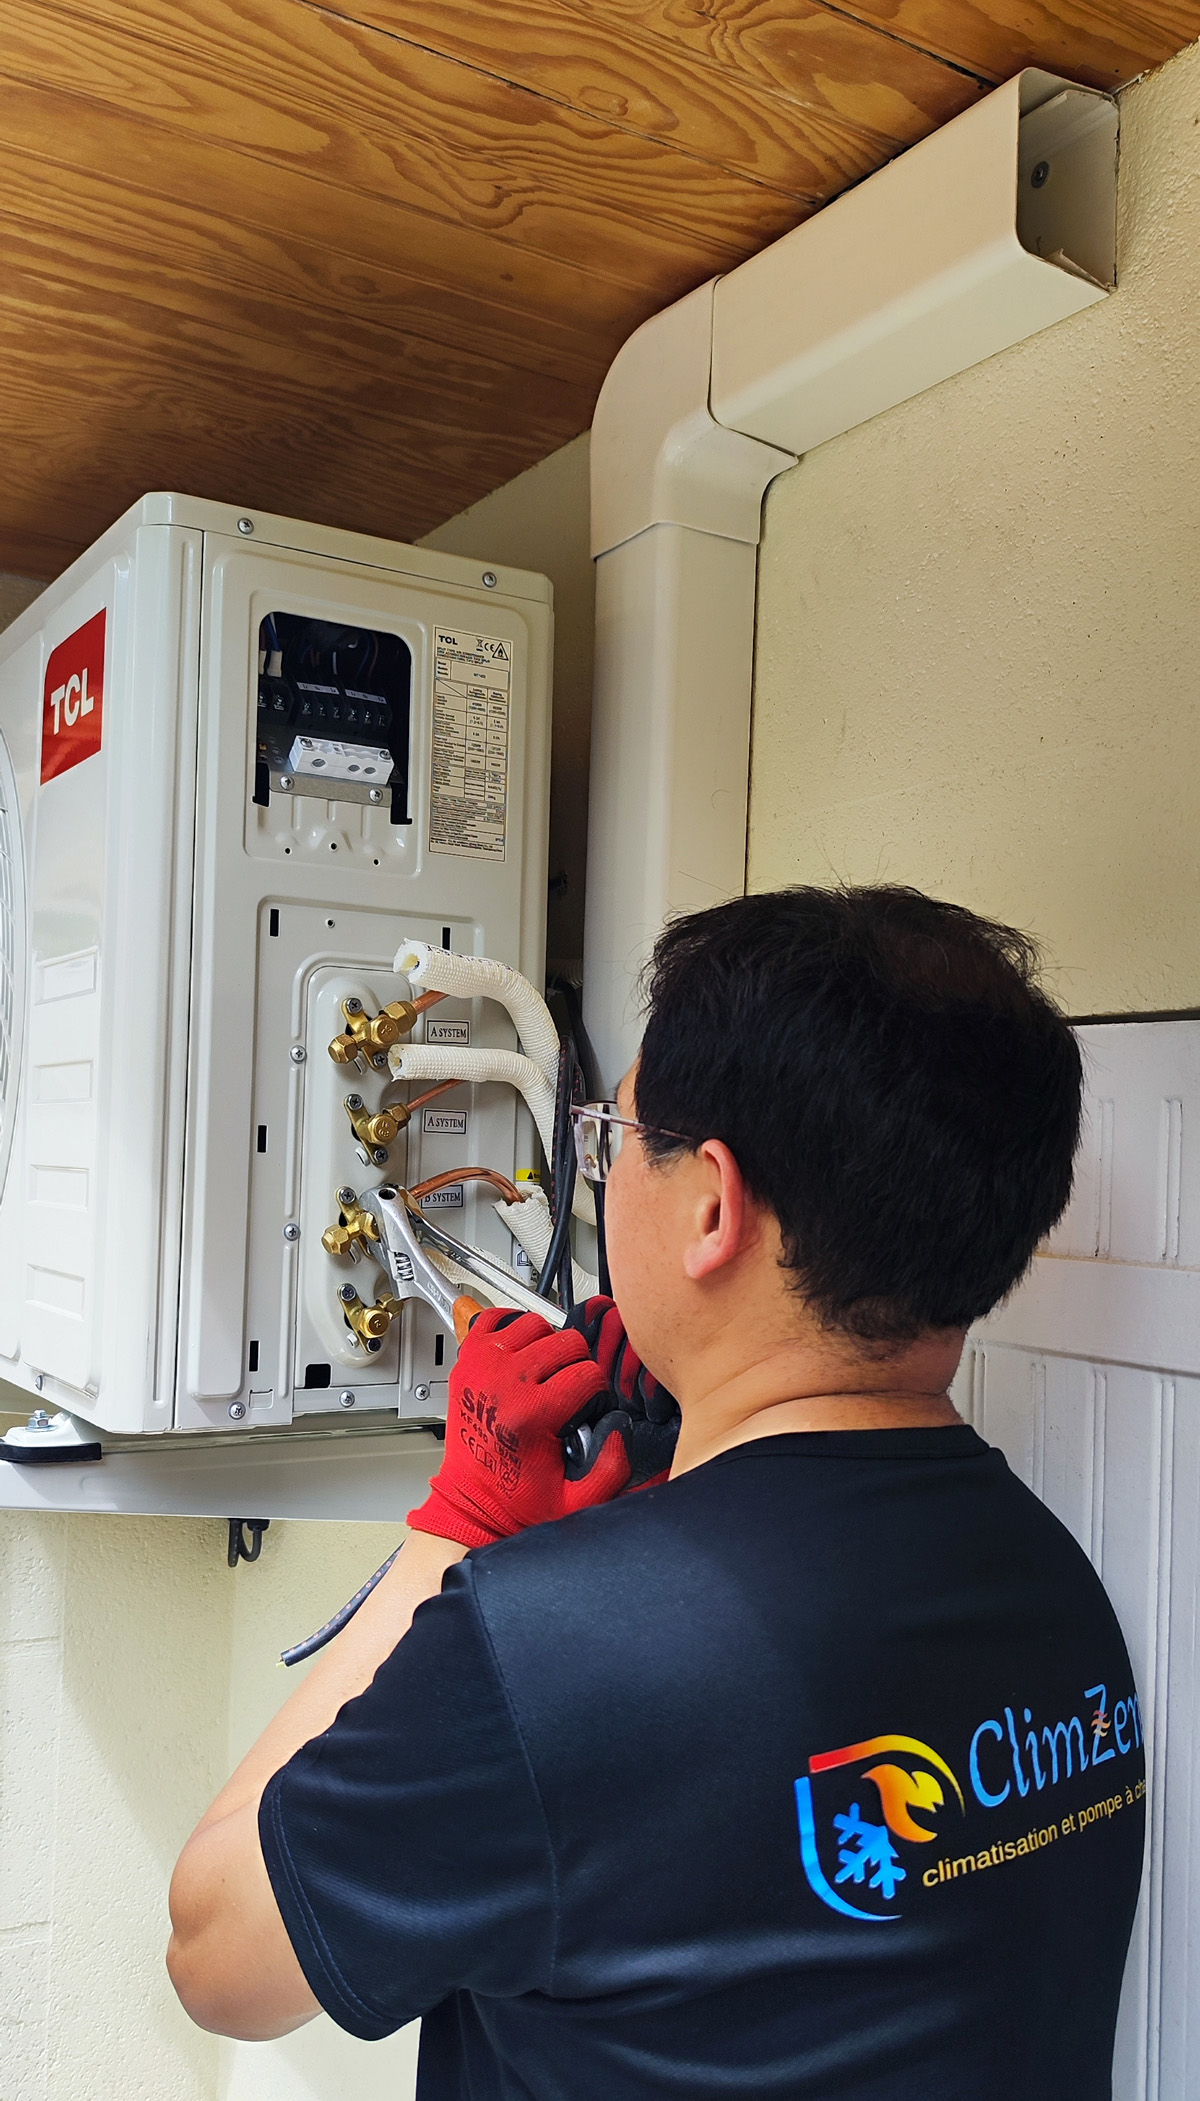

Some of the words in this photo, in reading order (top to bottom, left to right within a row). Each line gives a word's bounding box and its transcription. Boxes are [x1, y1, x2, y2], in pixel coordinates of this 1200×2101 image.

[438, 635, 458, 646] TCL
[50, 667, 95, 736] TCL
[430, 1026, 437, 1037] A
[438, 1027, 467, 1039] SYSTEM
[427, 1116, 435, 1127] A
[435, 1117, 464, 1128] SYSTEM
[432, 1192, 461, 1202] SYSTEM
[968, 1683, 1146, 1808] ClimZen
[922, 1824, 1059, 1888] climatisation
[1061, 1812, 1077, 1836] et
[1078, 1794, 1123, 1833] pompe
[1125, 1785, 1134, 1805] à
